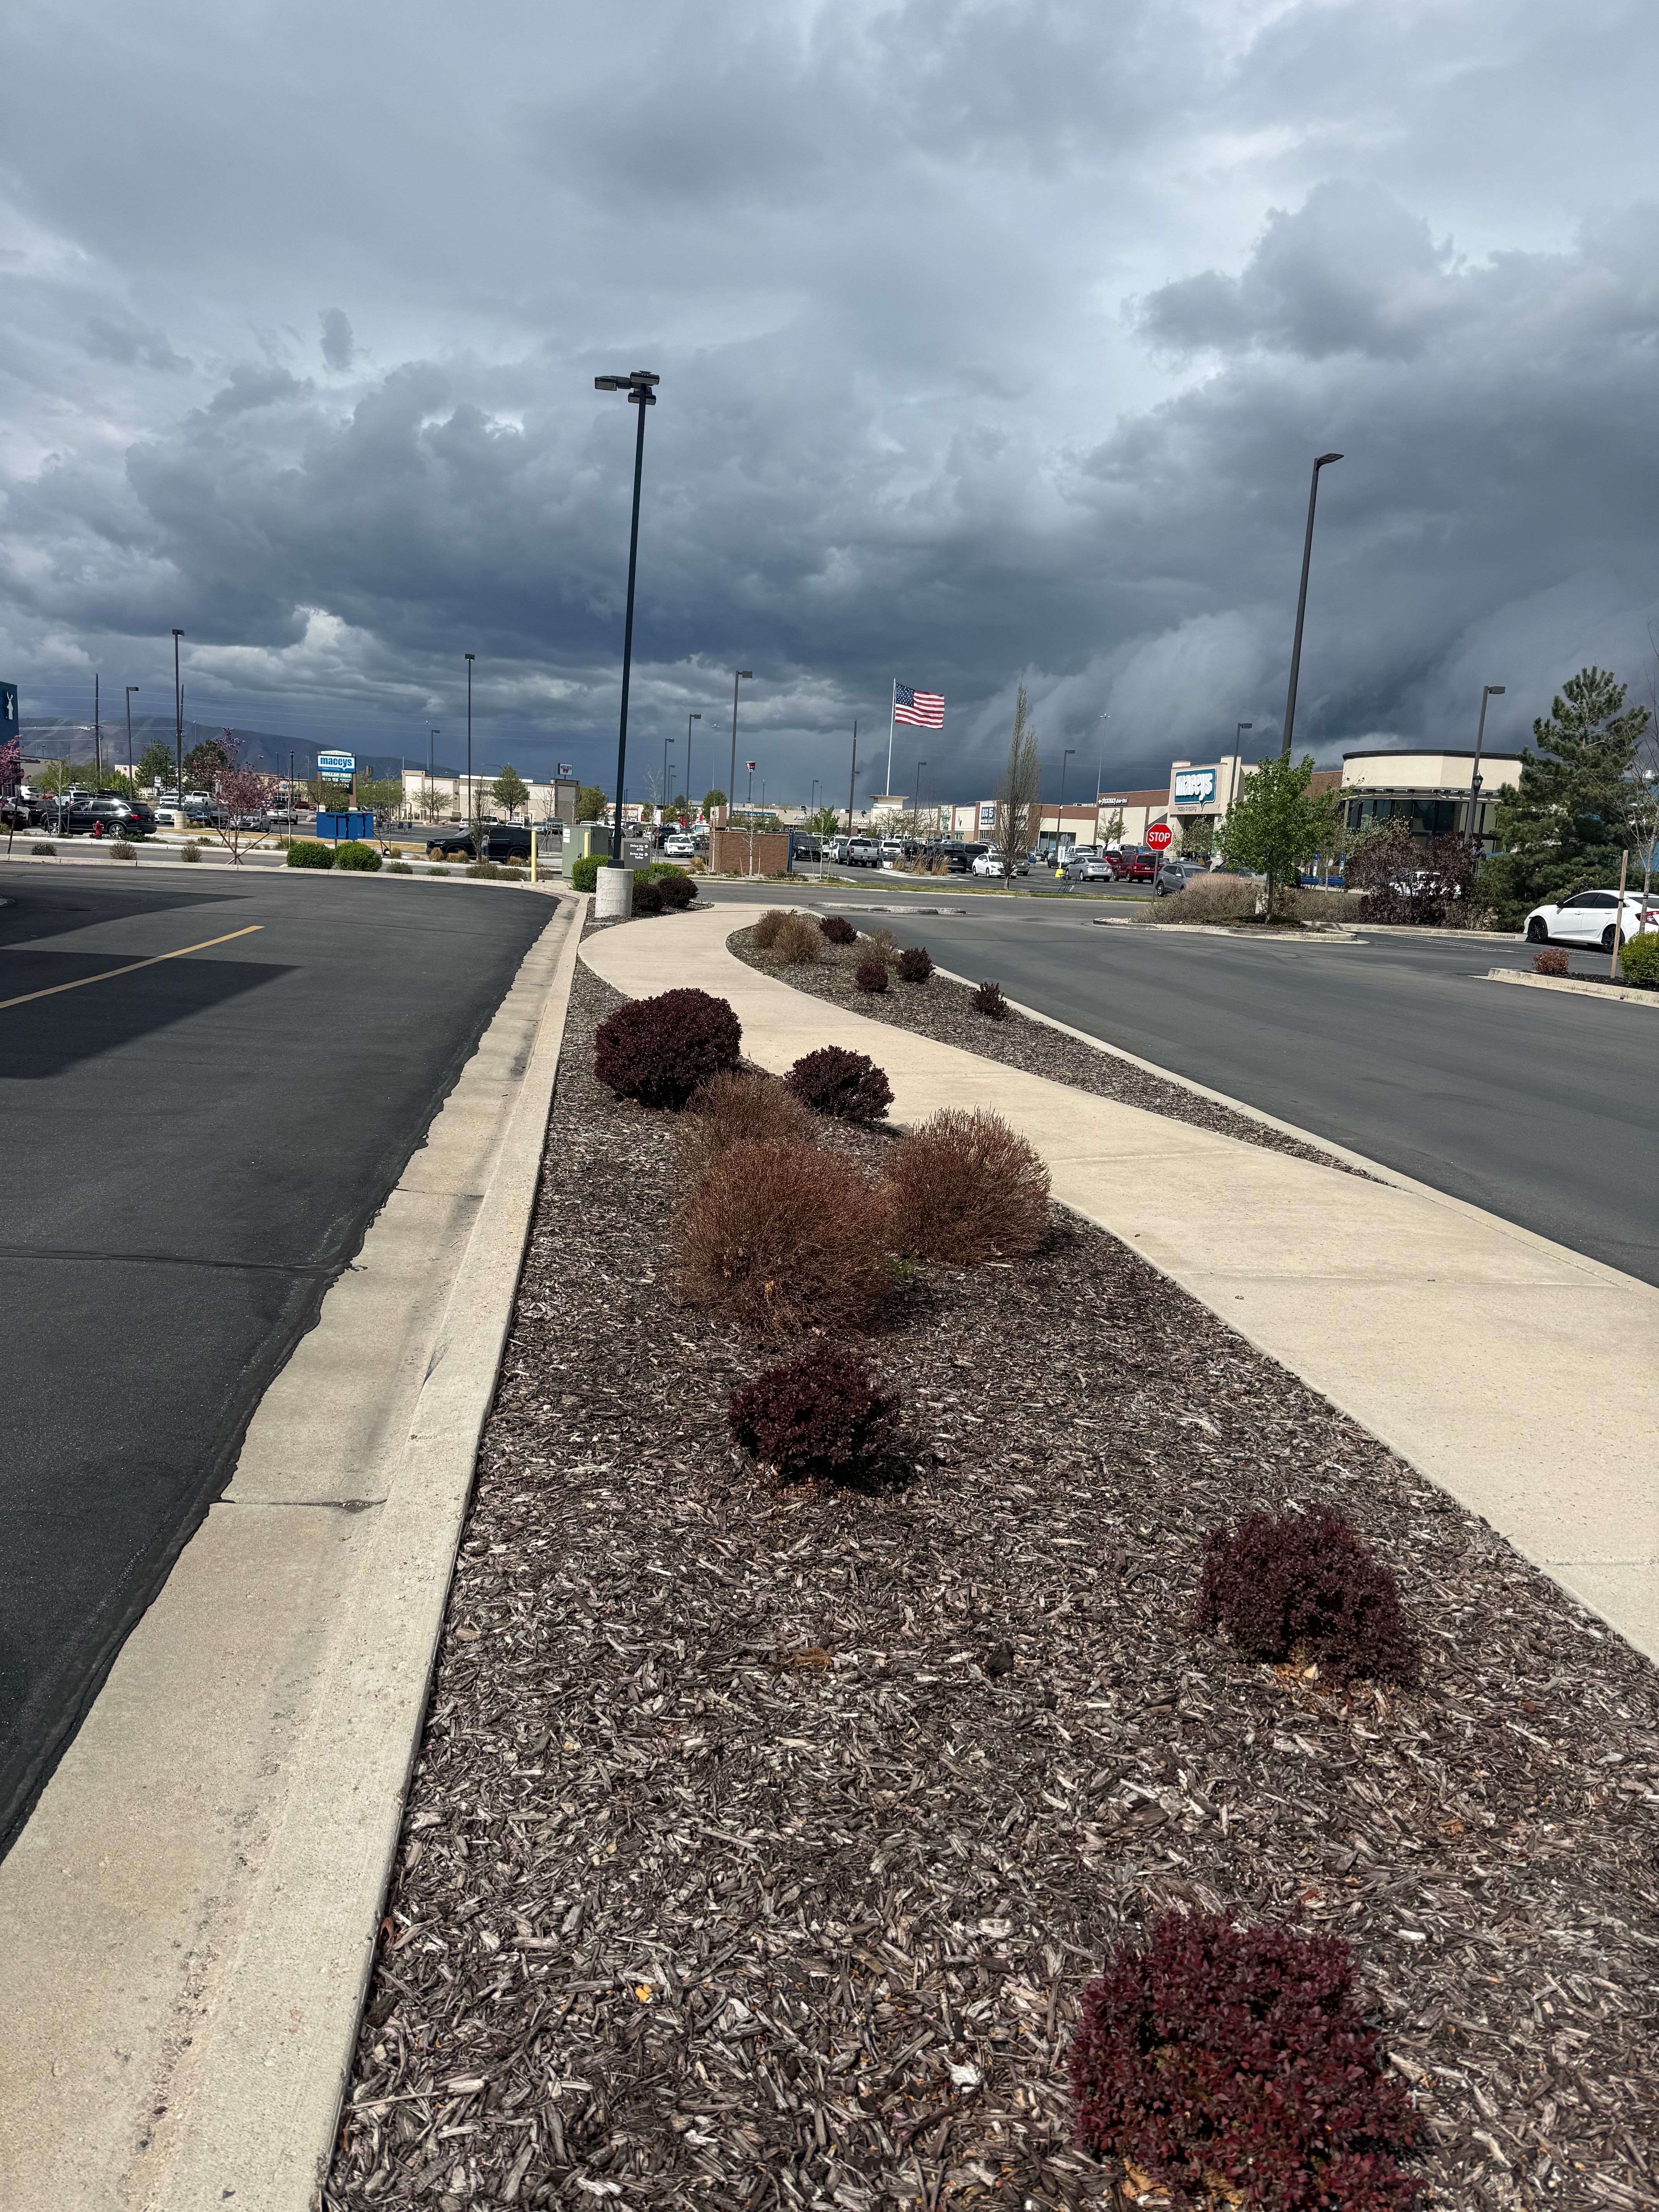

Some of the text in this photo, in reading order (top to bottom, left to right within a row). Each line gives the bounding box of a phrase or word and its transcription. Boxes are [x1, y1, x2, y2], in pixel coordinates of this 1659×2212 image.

[320, 757, 352, 768] maceys
[1176, 773, 1212, 800] maceys
[989, 808, 993, 818] 5
[1149, 832, 1170, 842] STOP
